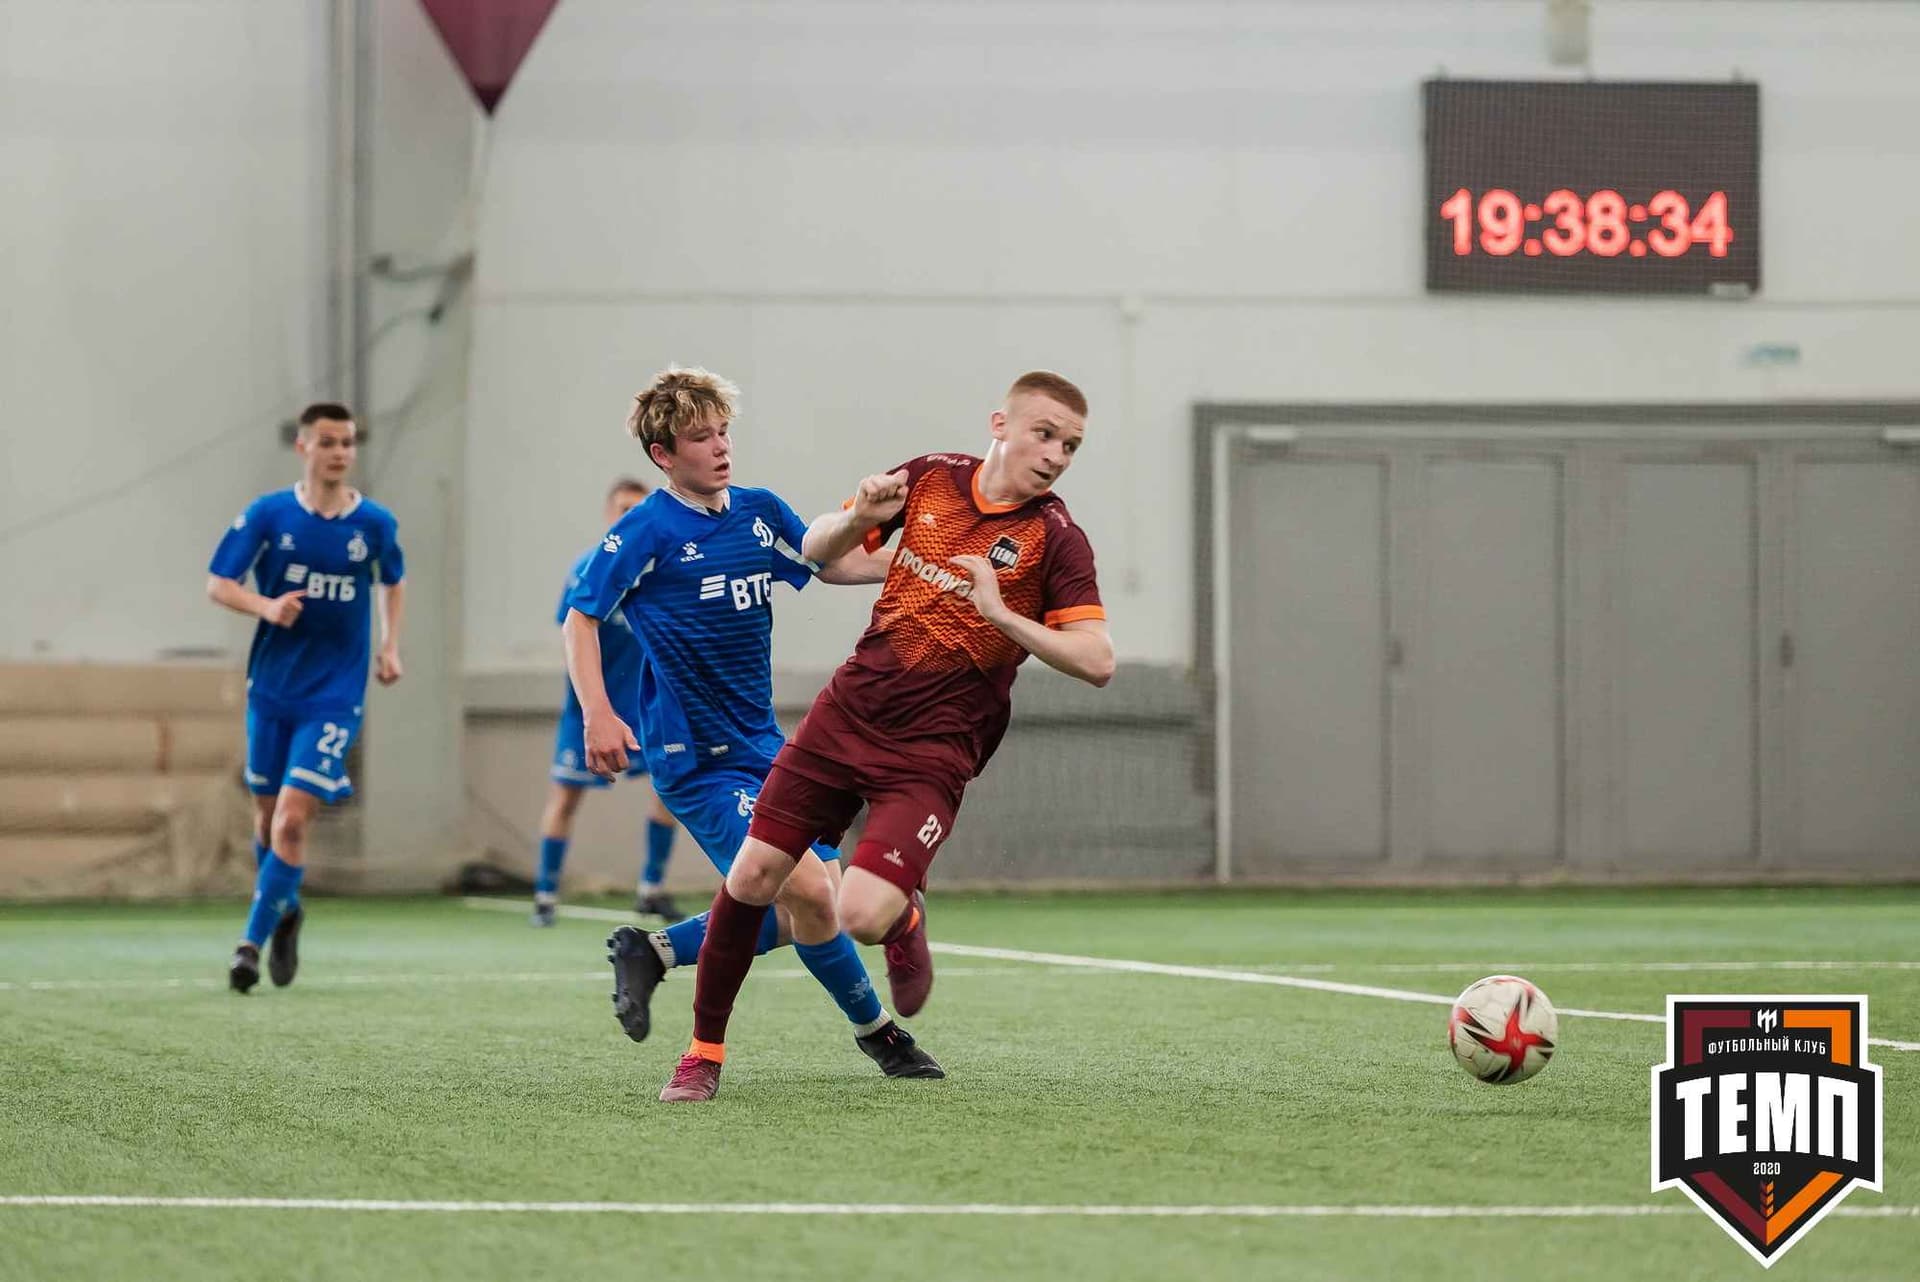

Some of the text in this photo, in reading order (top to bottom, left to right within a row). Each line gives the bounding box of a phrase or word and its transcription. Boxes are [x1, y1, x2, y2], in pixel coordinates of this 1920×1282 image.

[1440, 188, 1733, 257] 19:38:34
[307, 571, 356, 602] ВТБ
[317, 722, 349, 759] 22
